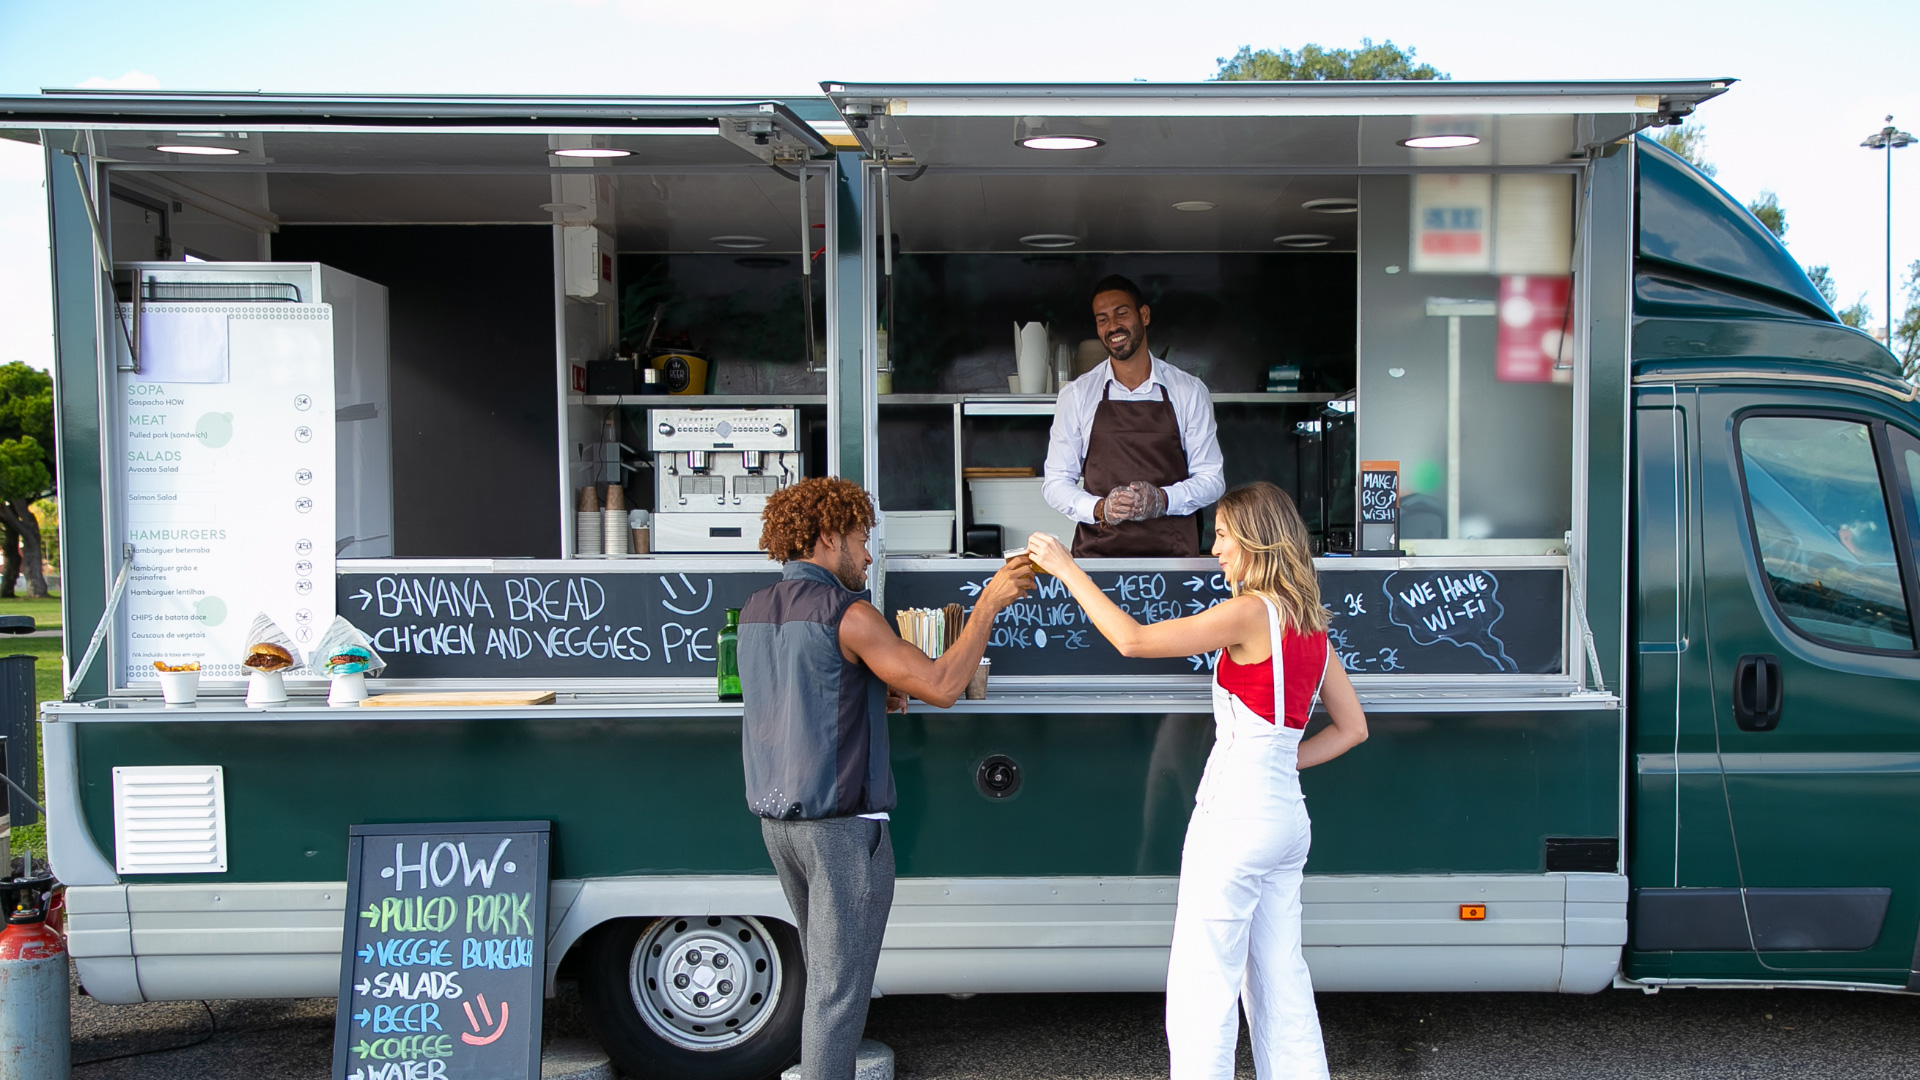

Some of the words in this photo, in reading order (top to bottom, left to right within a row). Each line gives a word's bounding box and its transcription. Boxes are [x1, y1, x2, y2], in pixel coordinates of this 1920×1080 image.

[127, 384, 165, 396] SOPA
[128, 398, 165, 407] Gaspacho
[129, 414, 167, 426] MEAT
[129, 431, 151, 439] Pulled
[152, 431, 169, 440] pork
[169, 431, 208, 440] (sandwich)
[127, 451, 182, 462] SALADS
[127, 466, 158, 474] Avocato
[1363, 472, 1392, 489] MAKE
[1391, 475, 1398, 489] A
[128, 493, 156, 502] Salmon
[157, 493, 178, 502] Salad
[129, 529, 227, 541] HAMBURGERS
[175, 588, 206, 596] lentilhas
[1399, 581, 1437, 608] WE
[1437, 573, 1488, 603] HAVE
[376, 576, 495, 618] BANANA
[505, 577, 605, 623] BREAD
[176, 632, 206, 640] vegetais
[485, 626, 533, 660] AND
[395, 838, 512, 892] HOW
[380, 895, 459, 934] PULLED
[466, 892, 534, 936] PORK
[371, 971, 464, 1001] SALADS
[373, 1003, 443, 1034] BEER
[370, 1034, 454, 1060] COFFEE
[367, 1058, 449, 1080] WATER
